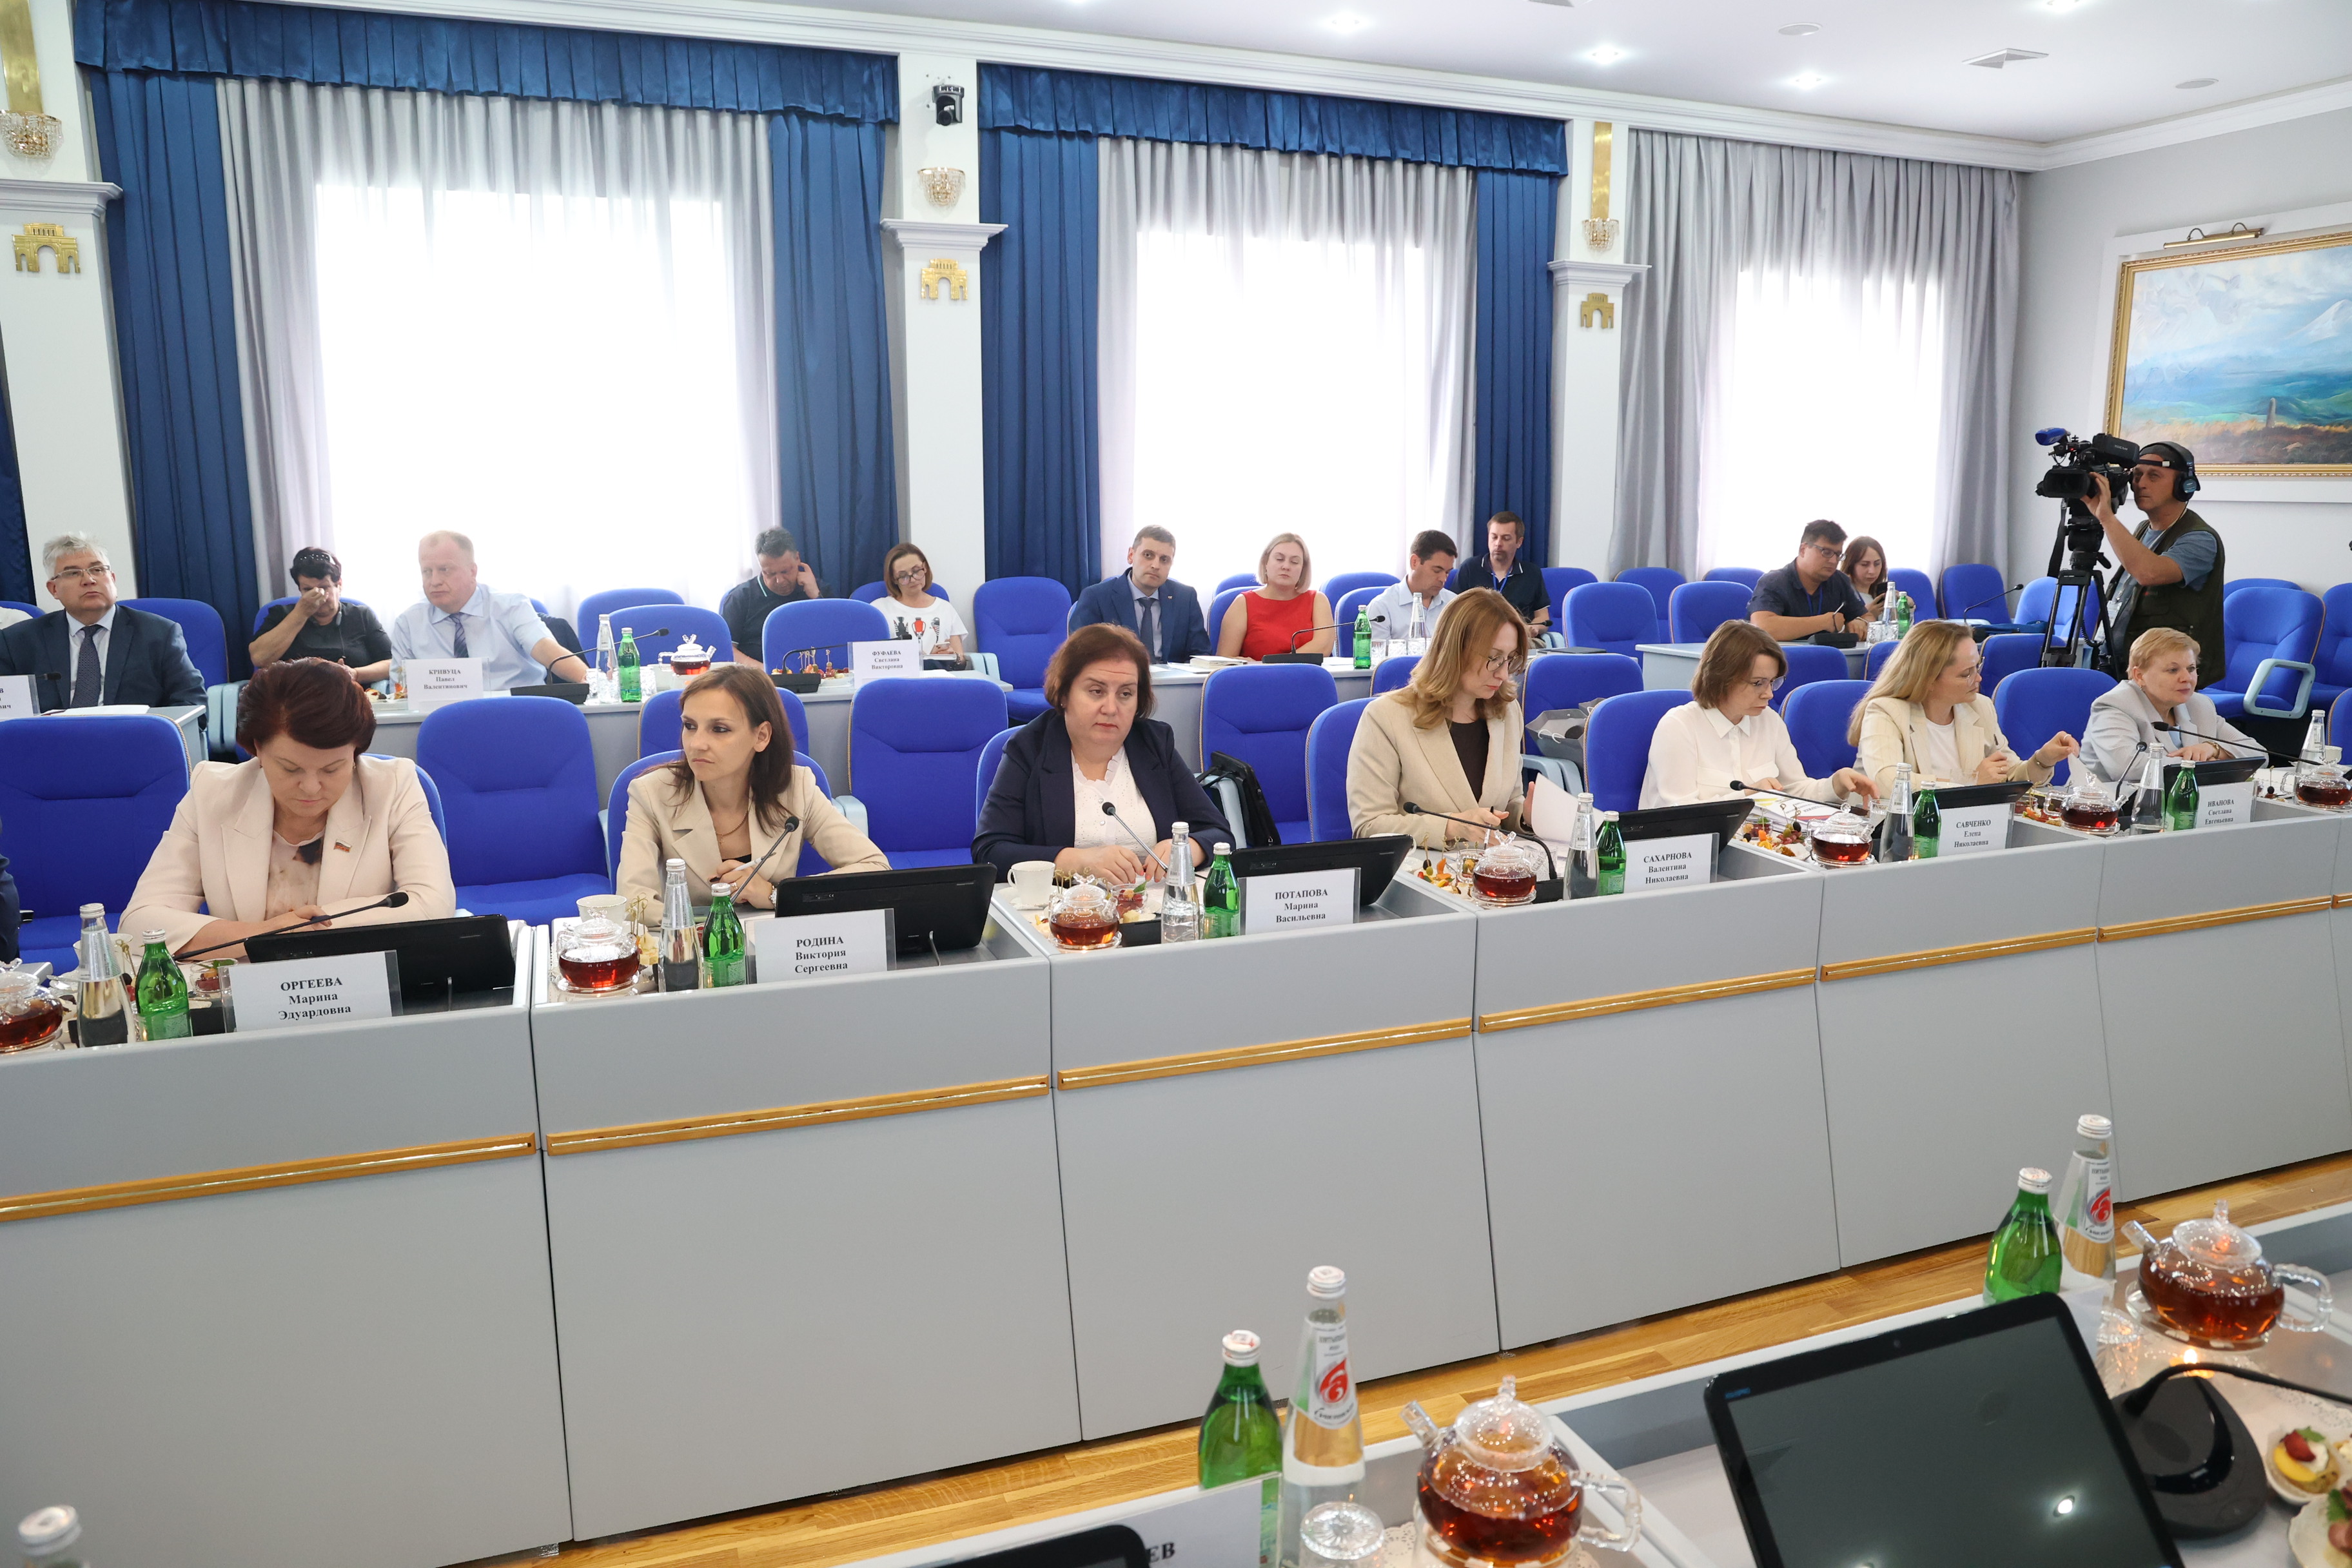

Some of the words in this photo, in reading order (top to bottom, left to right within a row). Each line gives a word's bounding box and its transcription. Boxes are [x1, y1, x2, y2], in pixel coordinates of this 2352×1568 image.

[2208, 799, 2234, 807] ИВАНОВА
[1956, 819, 1991, 828] САВЧЕНКО
[1643, 852, 1692, 863] САХАРНОВА
[1649, 864, 1686, 873] Валентина
[1645, 874, 1689, 884] Николаевна
[1275, 889, 1328, 899] ПОТАПОВА
[1284, 903, 1318, 912] Марина
[1276, 914, 1326, 923] Васильевна
[796, 936, 844, 948] РОДИНА
[796, 950, 846, 961] Виктория
[795, 963, 848, 974] Сергеевна
[280, 977, 342, 991] ОРГЕЕВА
[289, 993, 338, 1005] Марина
[278, 1006, 351, 1020] Эдуардовна
